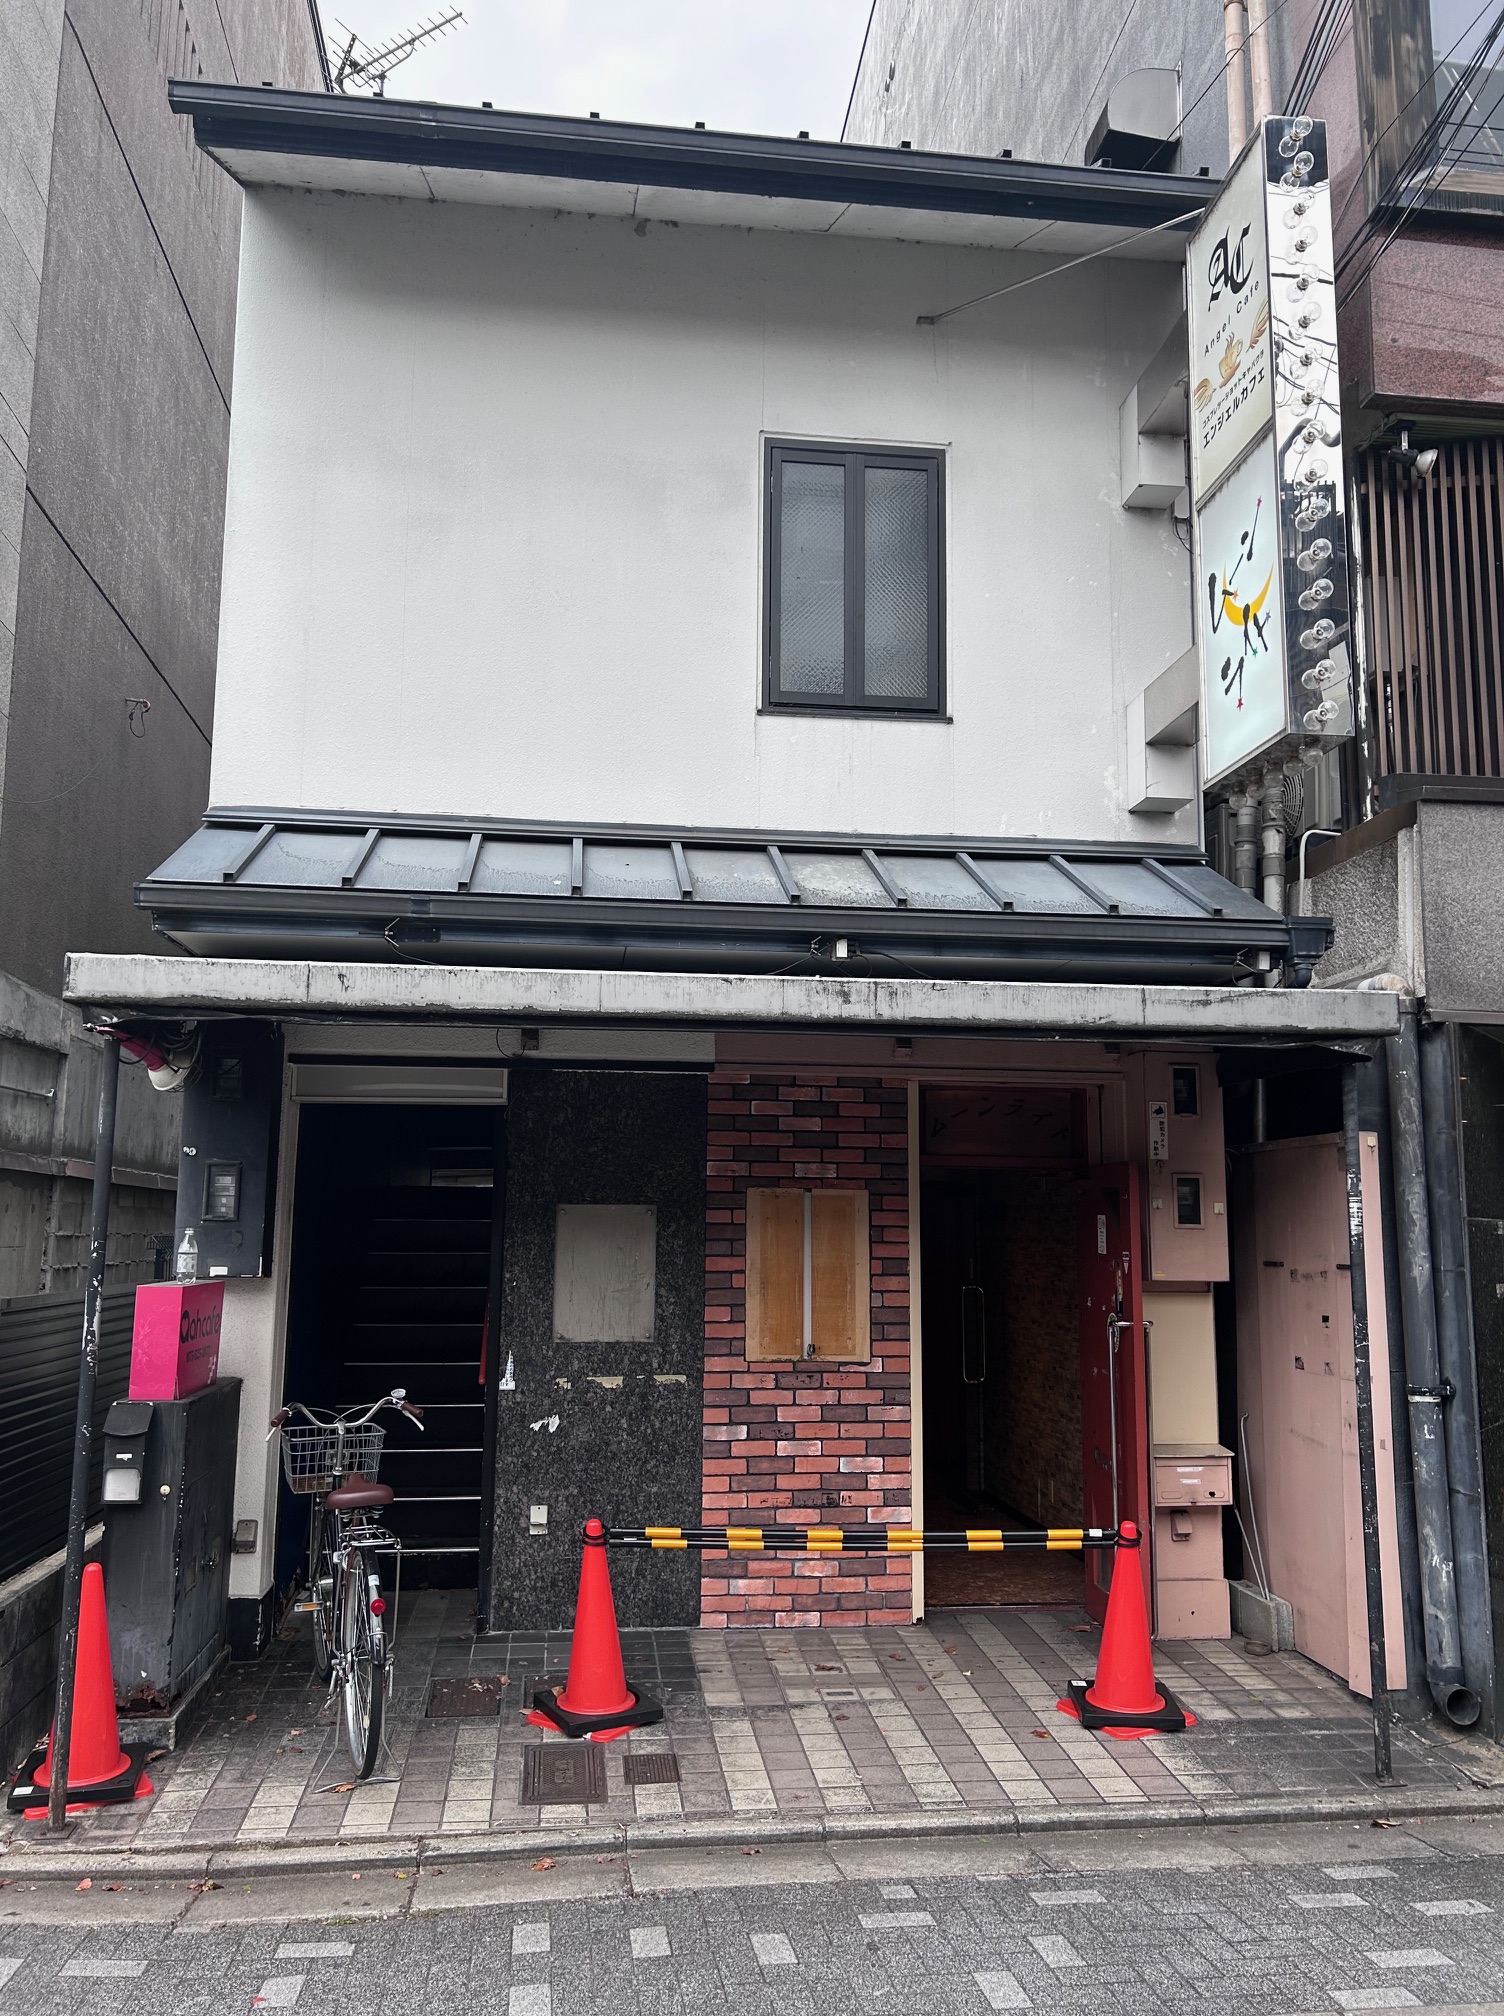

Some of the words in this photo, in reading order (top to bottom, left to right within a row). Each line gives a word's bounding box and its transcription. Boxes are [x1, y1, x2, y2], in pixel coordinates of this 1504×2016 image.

[1207, 222, 1255, 312] AC
[1204, 315, 1231, 357] Angel
[1236, 280, 1260, 314] Cafe
[1203, 367, 1265, 449] エンジェルカフェ
